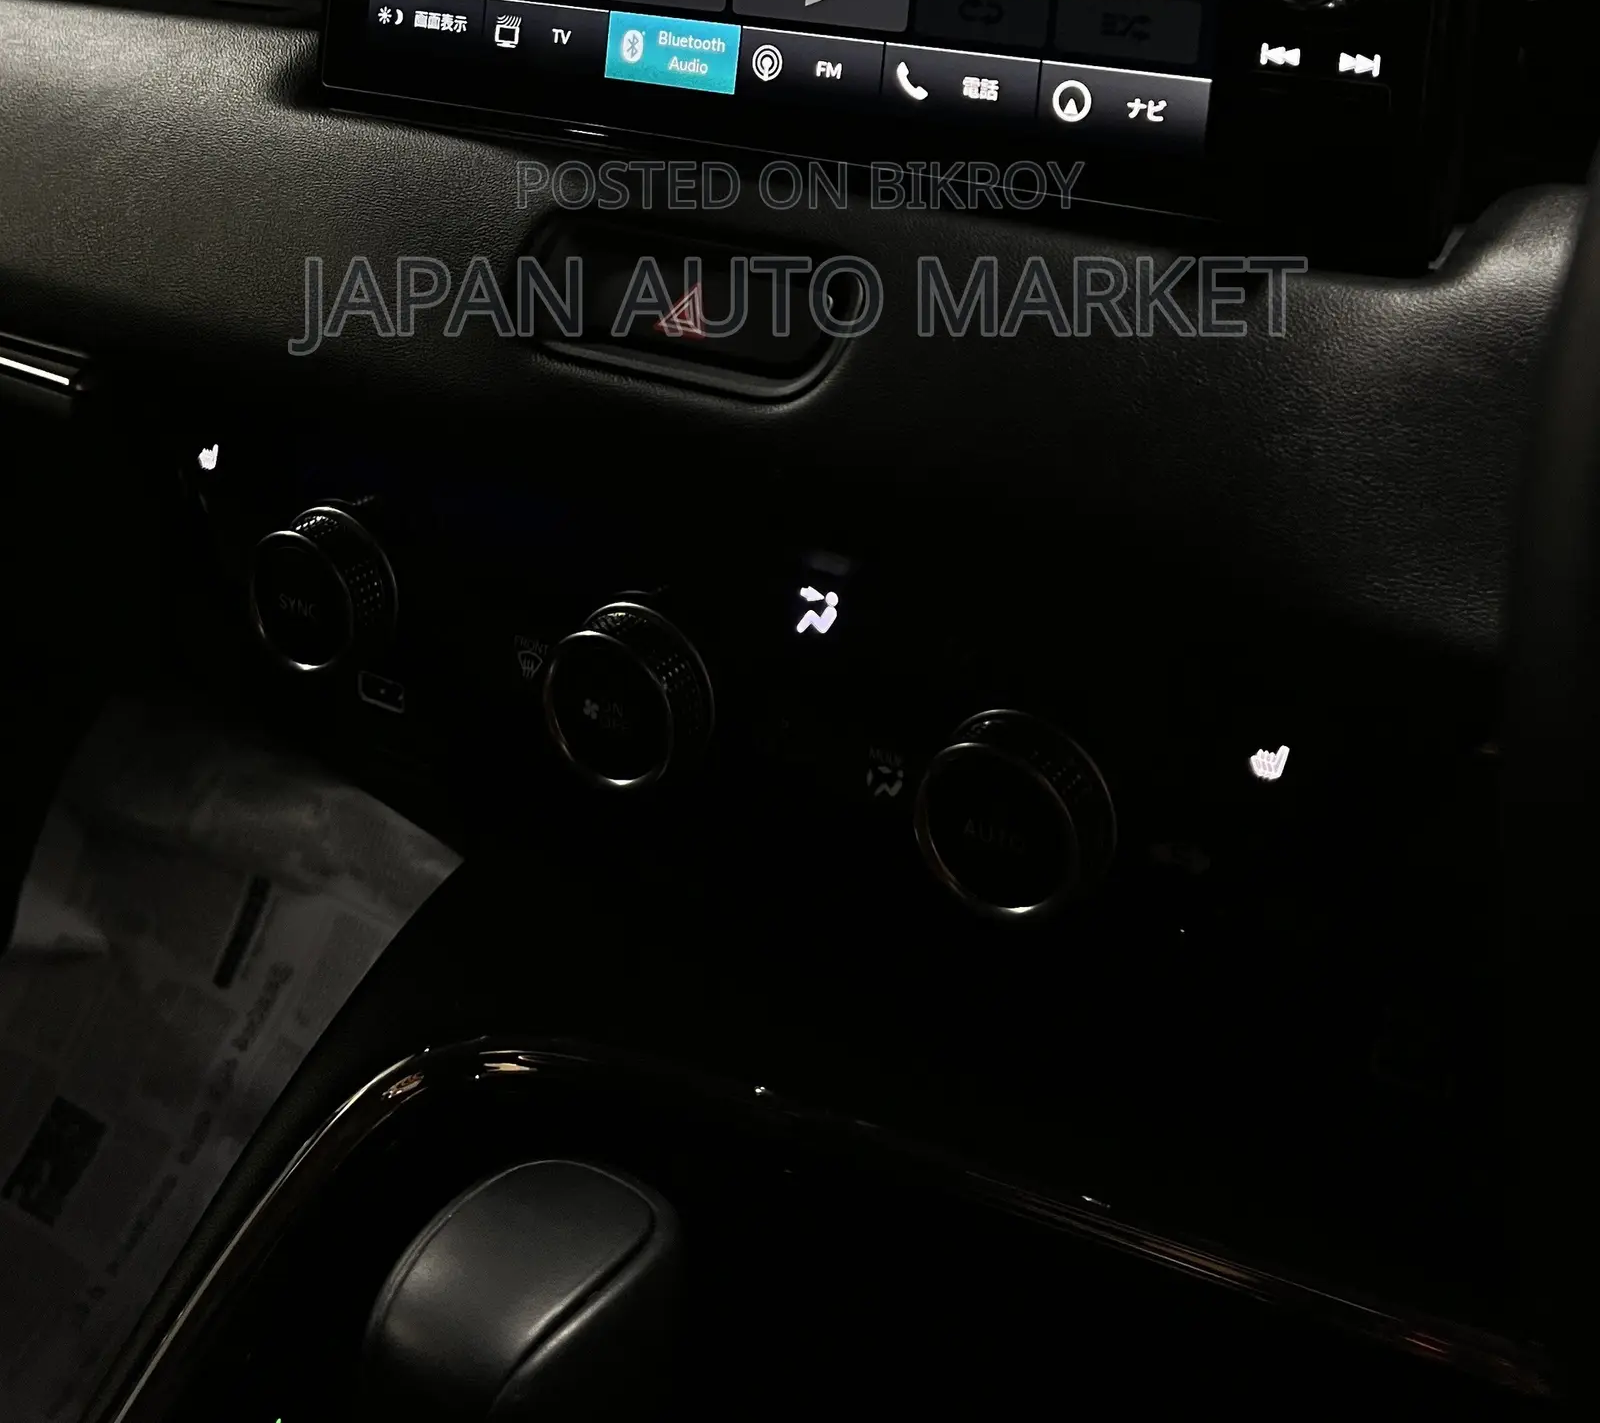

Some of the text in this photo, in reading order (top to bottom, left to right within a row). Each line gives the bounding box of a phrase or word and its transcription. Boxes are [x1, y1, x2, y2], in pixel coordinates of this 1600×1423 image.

[413, 10, 468, 33] 画面表示
[551, 28, 572, 46] TV
[658, 30, 726, 53] Bluetooth
[667, 55, 709, 76] Audio
[815, 60, 843, 80] FM
[962, 77, 1000, 103] 電話
[1126, 97, 1168, 123] ナビ
